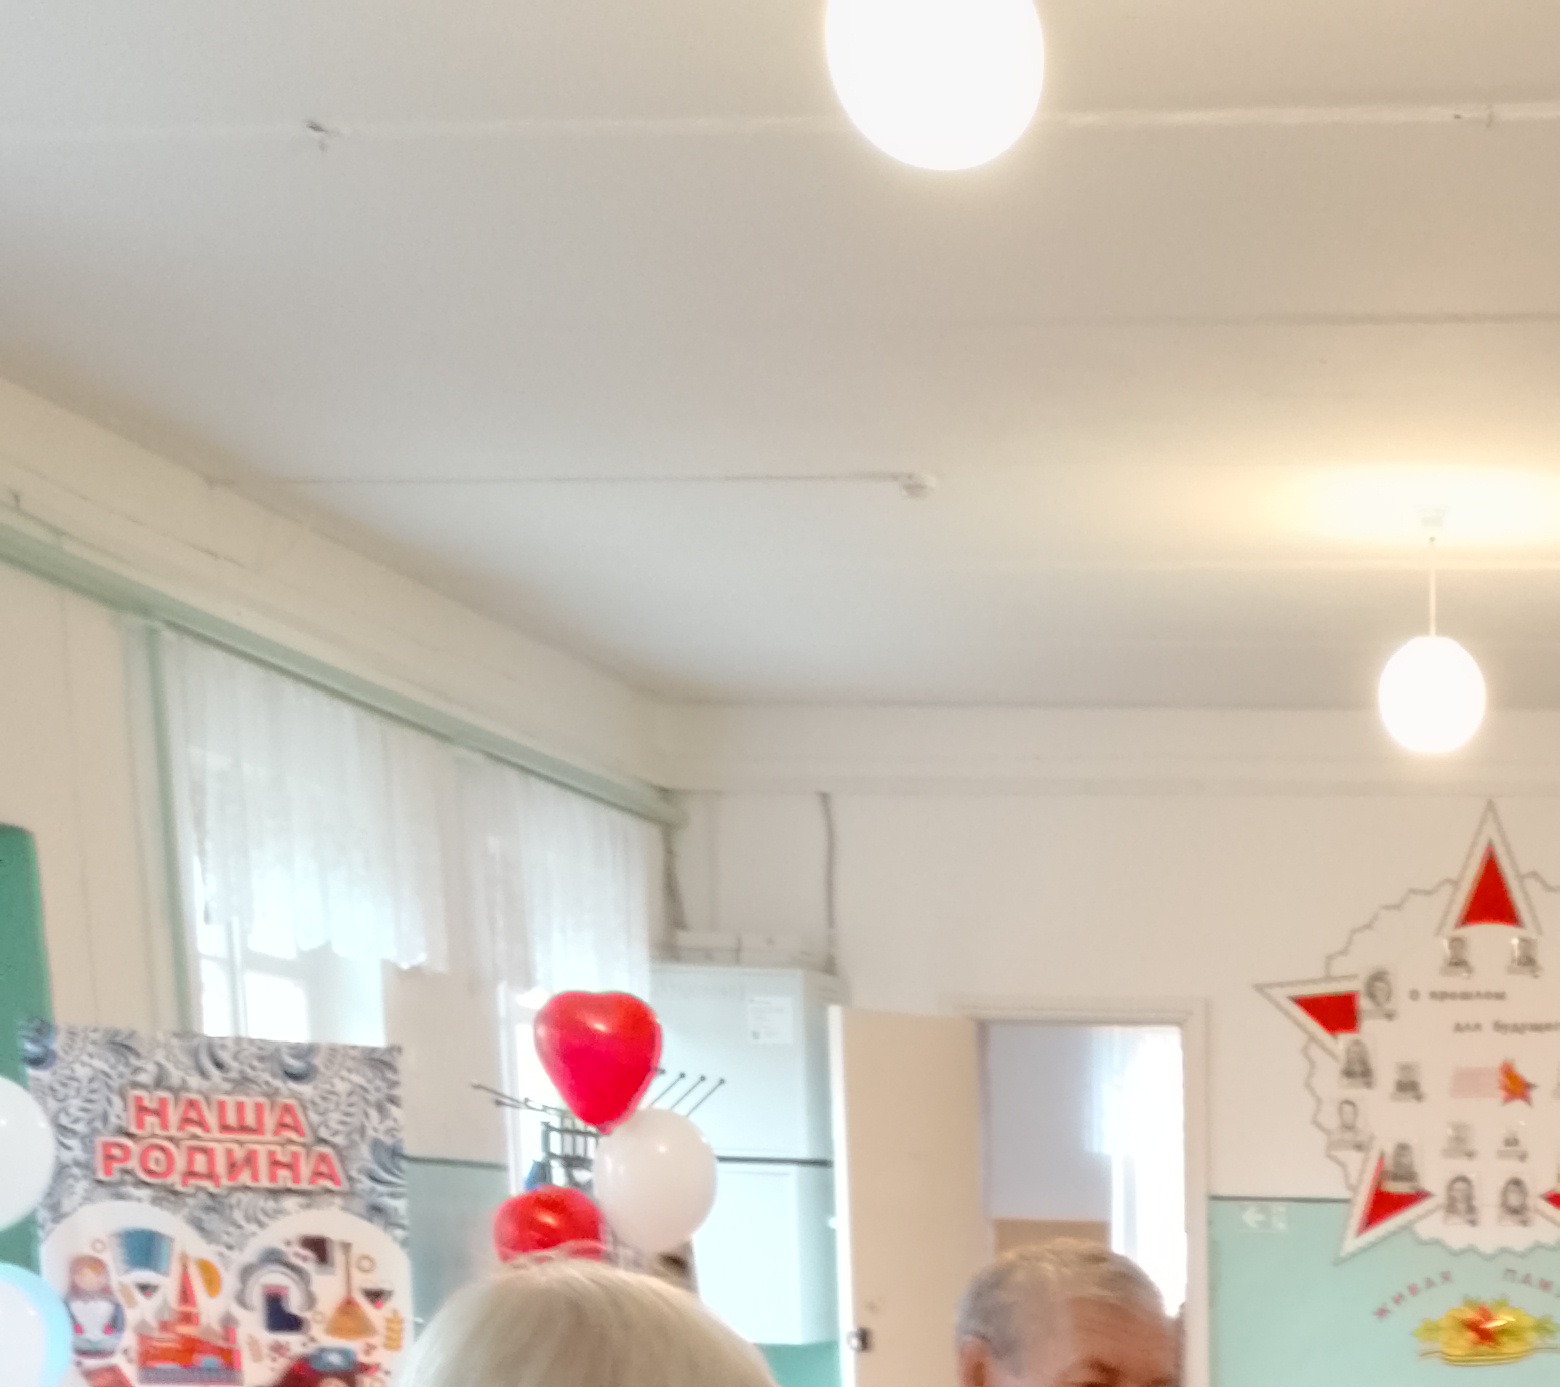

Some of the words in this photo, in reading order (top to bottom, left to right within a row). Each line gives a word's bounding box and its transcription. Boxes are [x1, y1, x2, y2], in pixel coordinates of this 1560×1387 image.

[131, 1092, 306, 1138] НАША
[99, 1140, 343, 1189] РОДИНА
[1374, 1270, 1453, 1319] ЖИВАЯ
